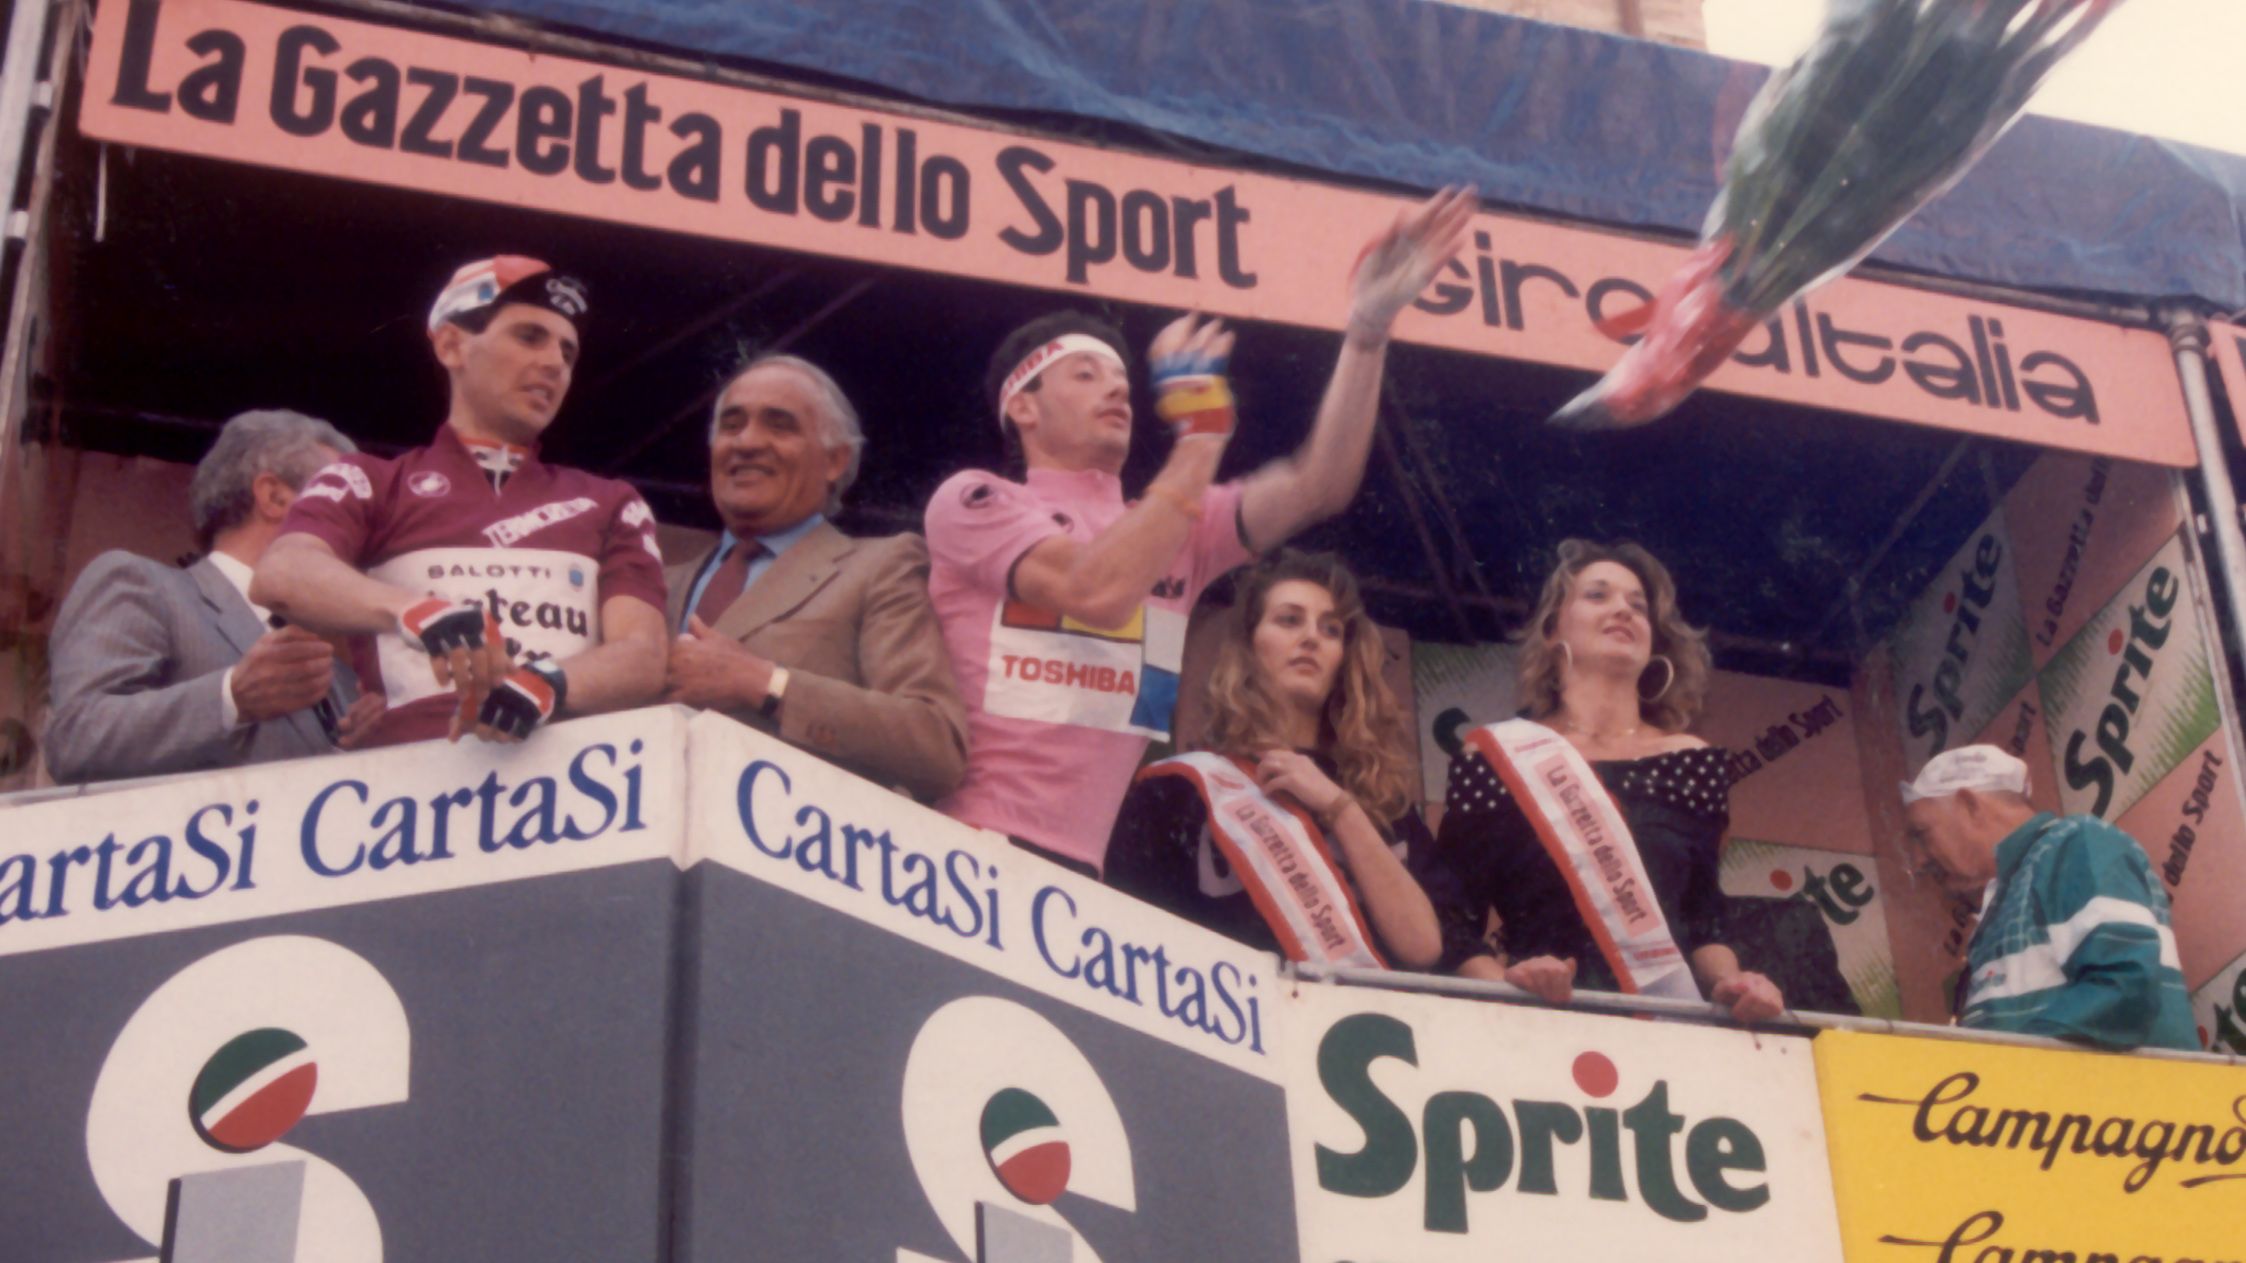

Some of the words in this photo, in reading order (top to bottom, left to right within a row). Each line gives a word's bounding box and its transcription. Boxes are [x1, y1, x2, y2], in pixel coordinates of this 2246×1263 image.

[109, 0, 246, 126] La
[269, 24, 722, 203] Gazzetta
[744, 108, 971, 240] dello
[995, 145, 1258, 290] Sport
[428, 564, 551, 580] SALOTTI
[1907, 533, 2002, 757] Sprite
[1002, 655, 1136, 696] TOSHIBA
[2064, 565, 2179, 818] Sprite
[0, 801, 260, 926] artaSi
[300, 738, 649, 878] CartaSi
[1547, 764, 1567, 788] La
[1560, 783, 1603, 847] Gazzetta
[1593, 844, 1623, 883] dello
[1612, 877, 1647, 925] Sport
[2182, 750, 2223, 826] Sport
[736, 759, 1005, 952] CartaSi
[1030, 885, 1266, 1055] CartaSi
[1235, 804, 1255, 823] La
[1249, 814, 1299, 875] Gazzetta
[1289, 871, 1320, 910] dello
[1311, 903, 1346, 950] Sport
[1314, 1012, 1771, 1234] Sprite
